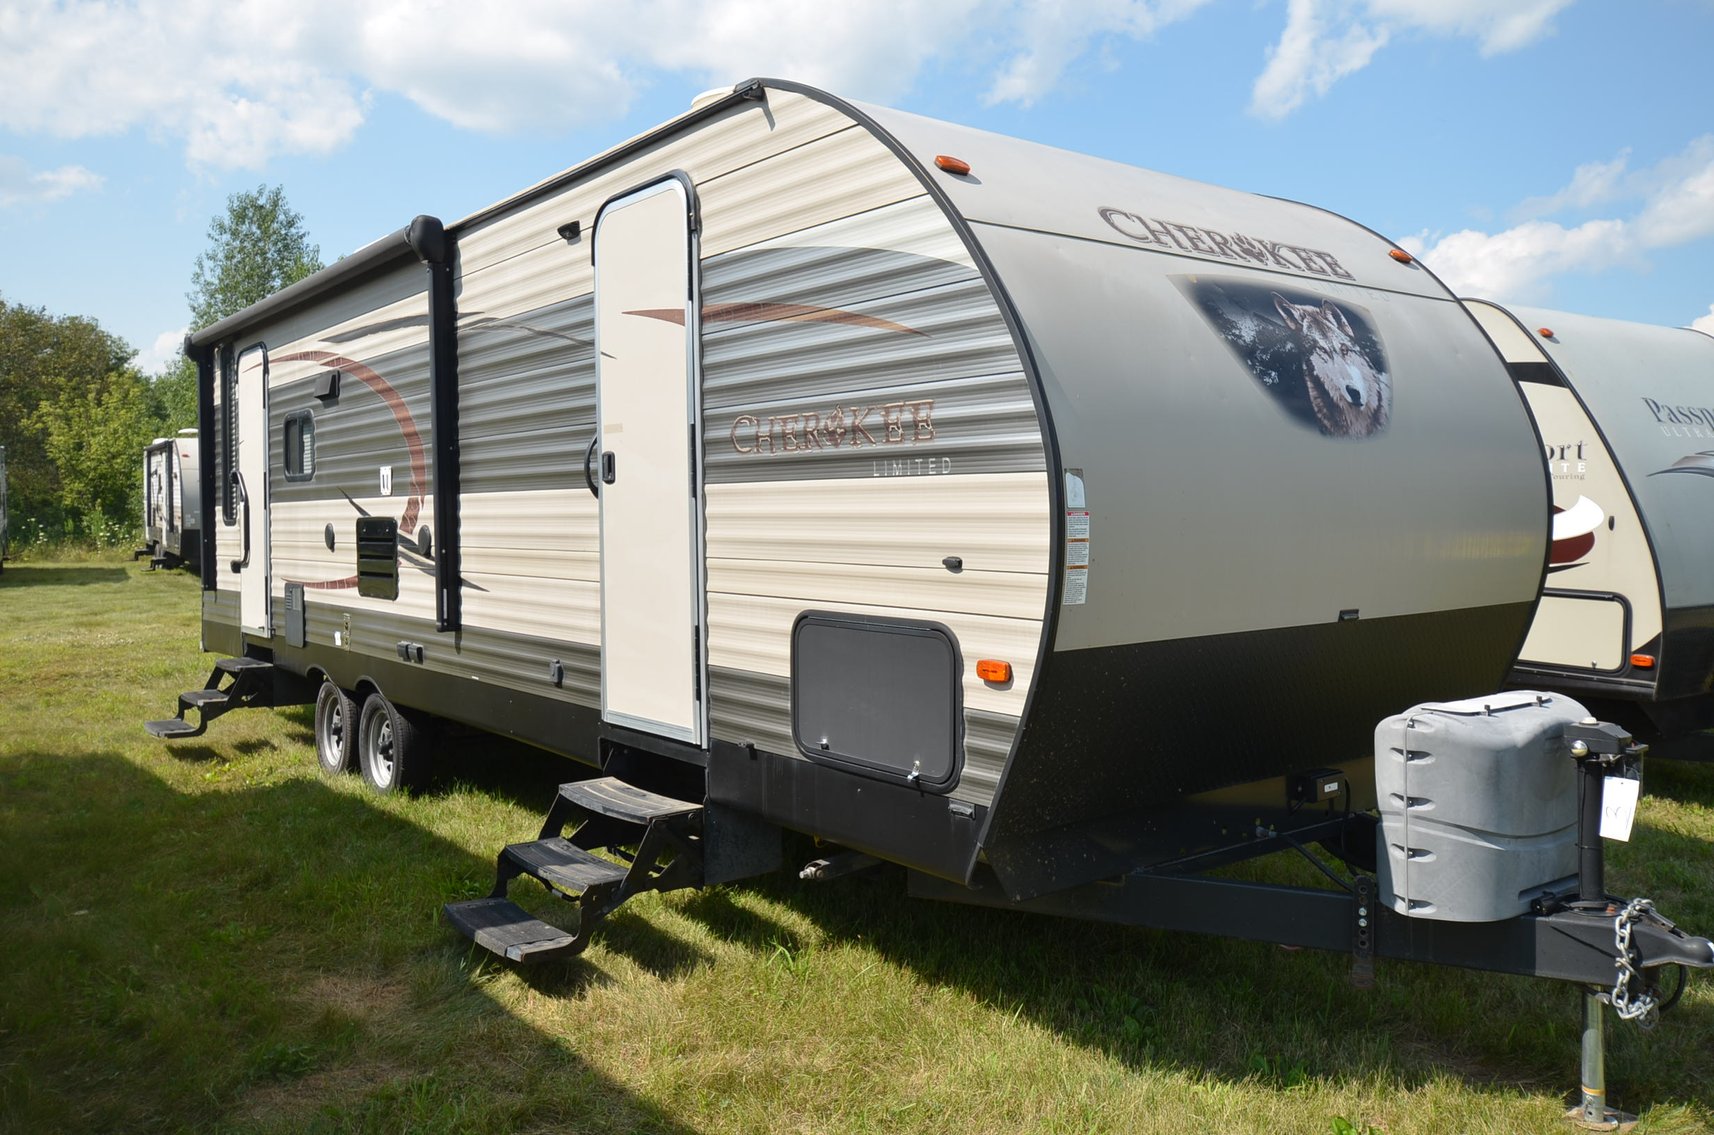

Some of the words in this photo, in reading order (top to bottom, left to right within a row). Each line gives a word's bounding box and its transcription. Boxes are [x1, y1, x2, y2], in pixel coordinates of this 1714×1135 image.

[1097, 206, 1356, 281] CHEROKEE
[730, 399, 936, 456] CHEROKEE
[873, 457, 951, 476] LIMITED
[1551, 473, 1586, 481] ouring
